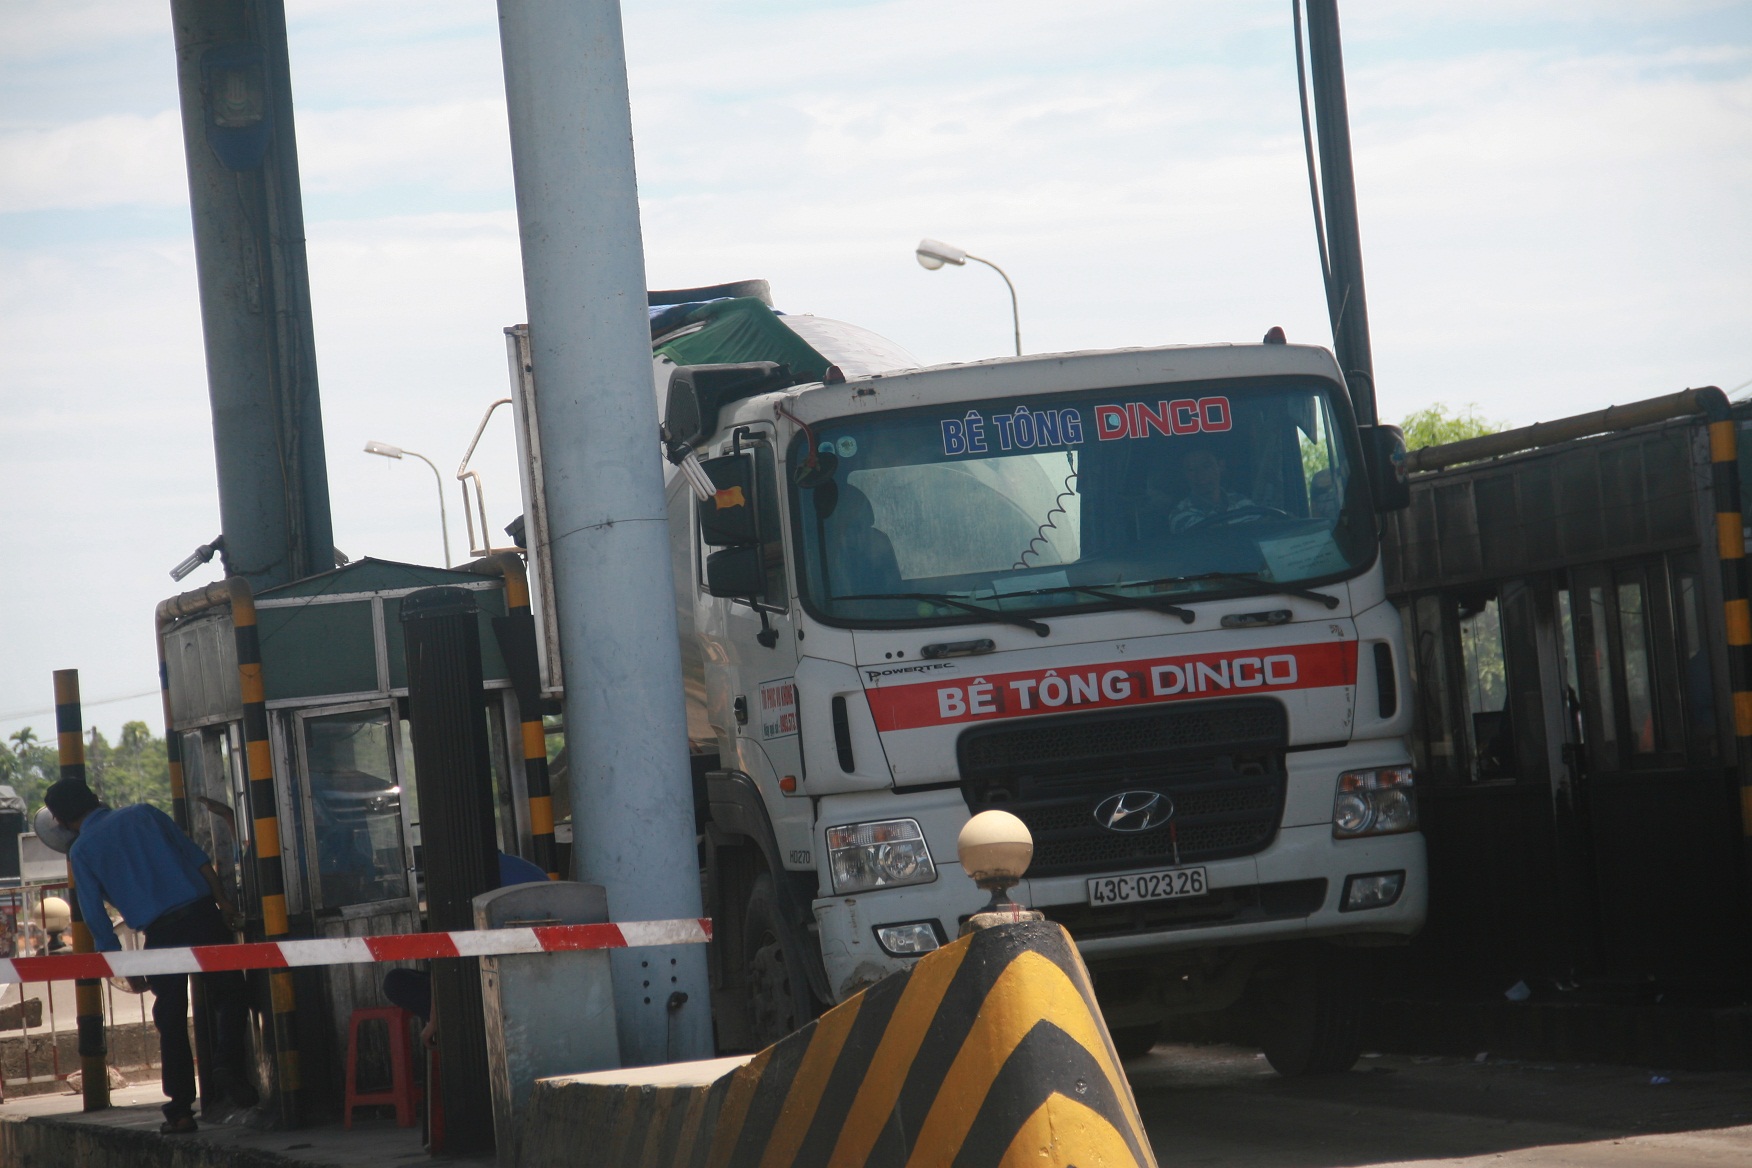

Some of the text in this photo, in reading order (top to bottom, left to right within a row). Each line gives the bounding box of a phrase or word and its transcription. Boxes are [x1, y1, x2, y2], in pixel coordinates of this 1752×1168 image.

[941, 396, 1233, 455] BÊ TÔNG DINCO
[866, 662, 955, 682] POWERTEC
[936, 654, 1298, 718] BÊ TÔNG DINCO
[790, 850, 810, 864] HD270
[1093, 871, 1203, 903] 43C-023.26
